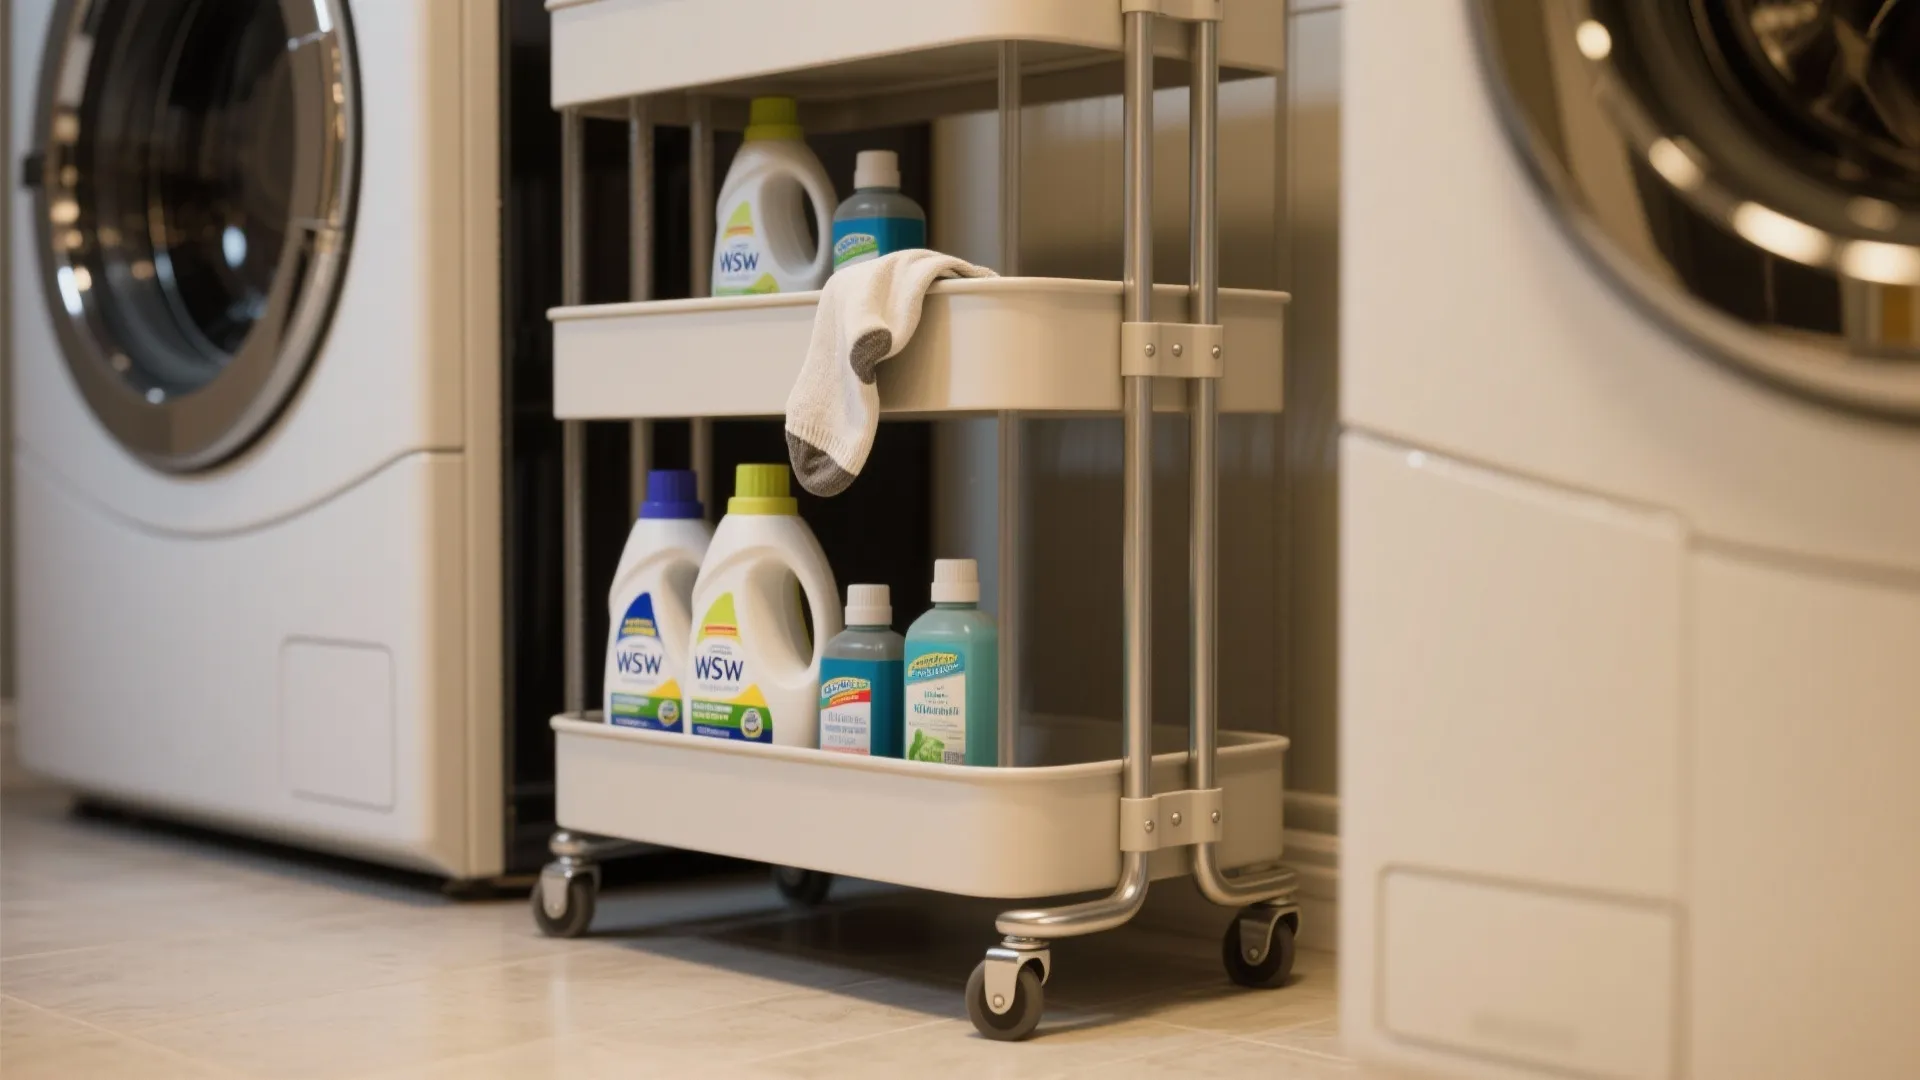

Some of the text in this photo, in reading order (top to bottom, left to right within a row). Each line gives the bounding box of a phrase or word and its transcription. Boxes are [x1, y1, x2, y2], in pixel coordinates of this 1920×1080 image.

[720, 252, 759, 273] WSW
[617, 650, 662, 675] WSW
[695, 655, 744, 682] WSW
